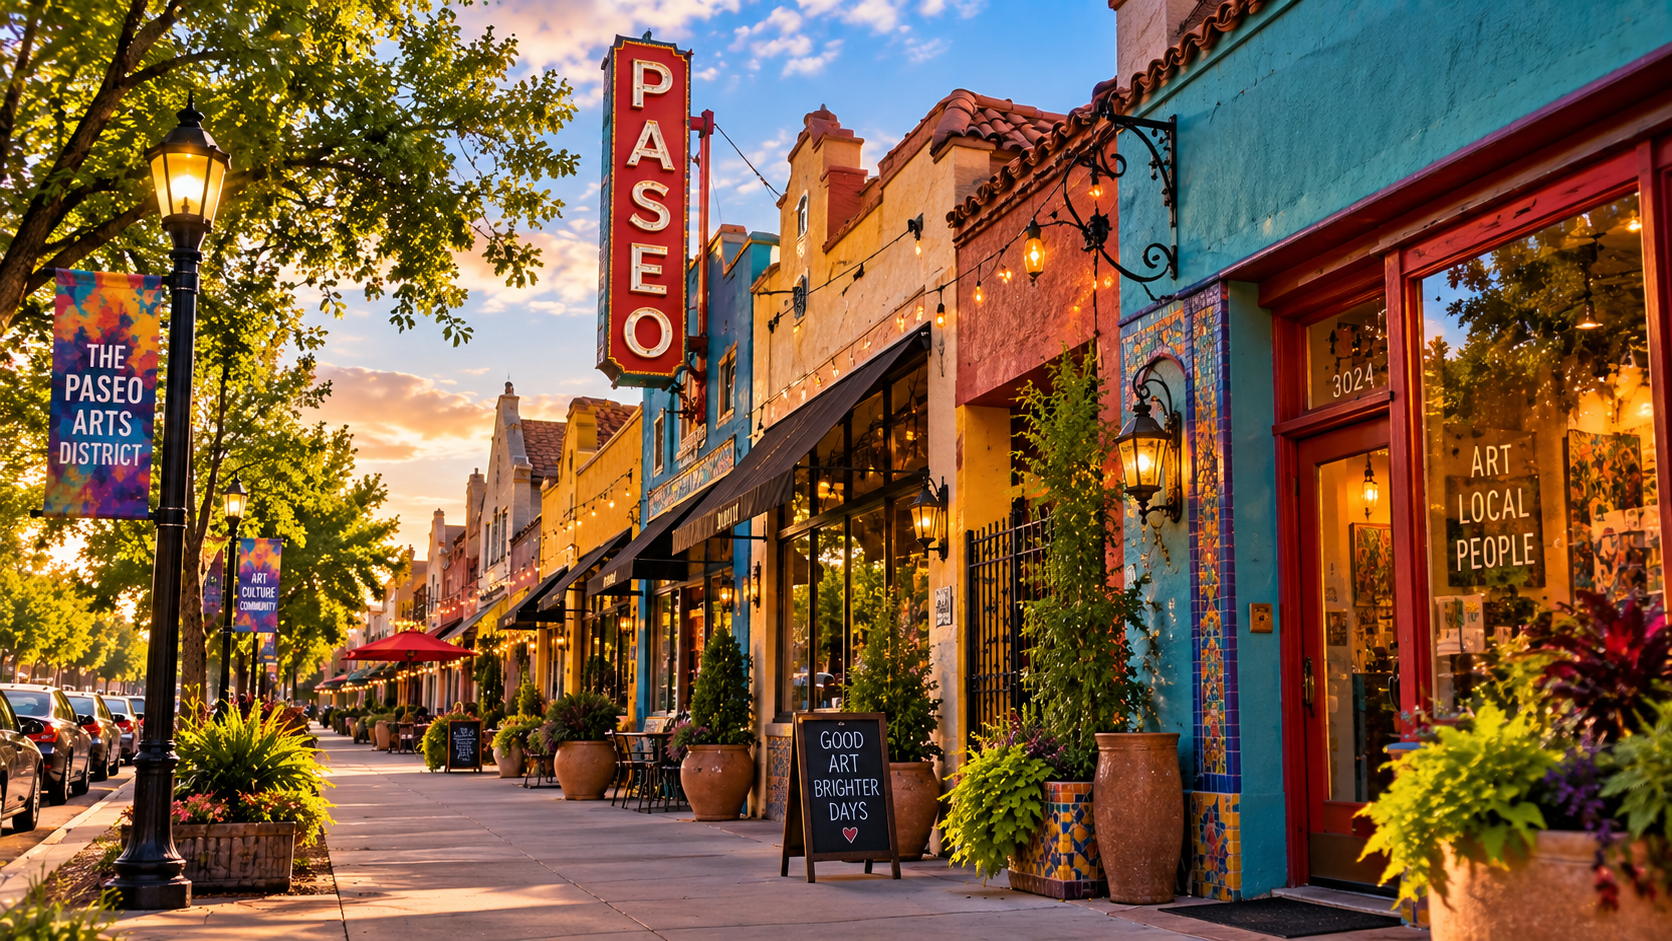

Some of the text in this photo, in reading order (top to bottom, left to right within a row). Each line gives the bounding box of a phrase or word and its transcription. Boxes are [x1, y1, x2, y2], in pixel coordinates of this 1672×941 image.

[623, 58, 676, 360] PASEO
[86, 343, 126, 370] THE
[65, 374, 143, 405] PASEO
[1332, 362, 1375, 399] 3024
[71, 409, 133, 438] ARTS
[58, 441, 143, 467] DISTRICT
[1471, 443, 1512, 479] ART
[1458, 487, 1530, 526] LOCAL
[1456, 532, 1536, 572] PEOPLE
[251, 572, 268, 584] ART
[241, 586, 276, 599] CULTURE
[820, 730, 864, 750] GOOD
[828, 753, 859, 774] ART
[813, 778, 880, 798] BRIGHTER
[829, 801, 868, 821] DAYS
